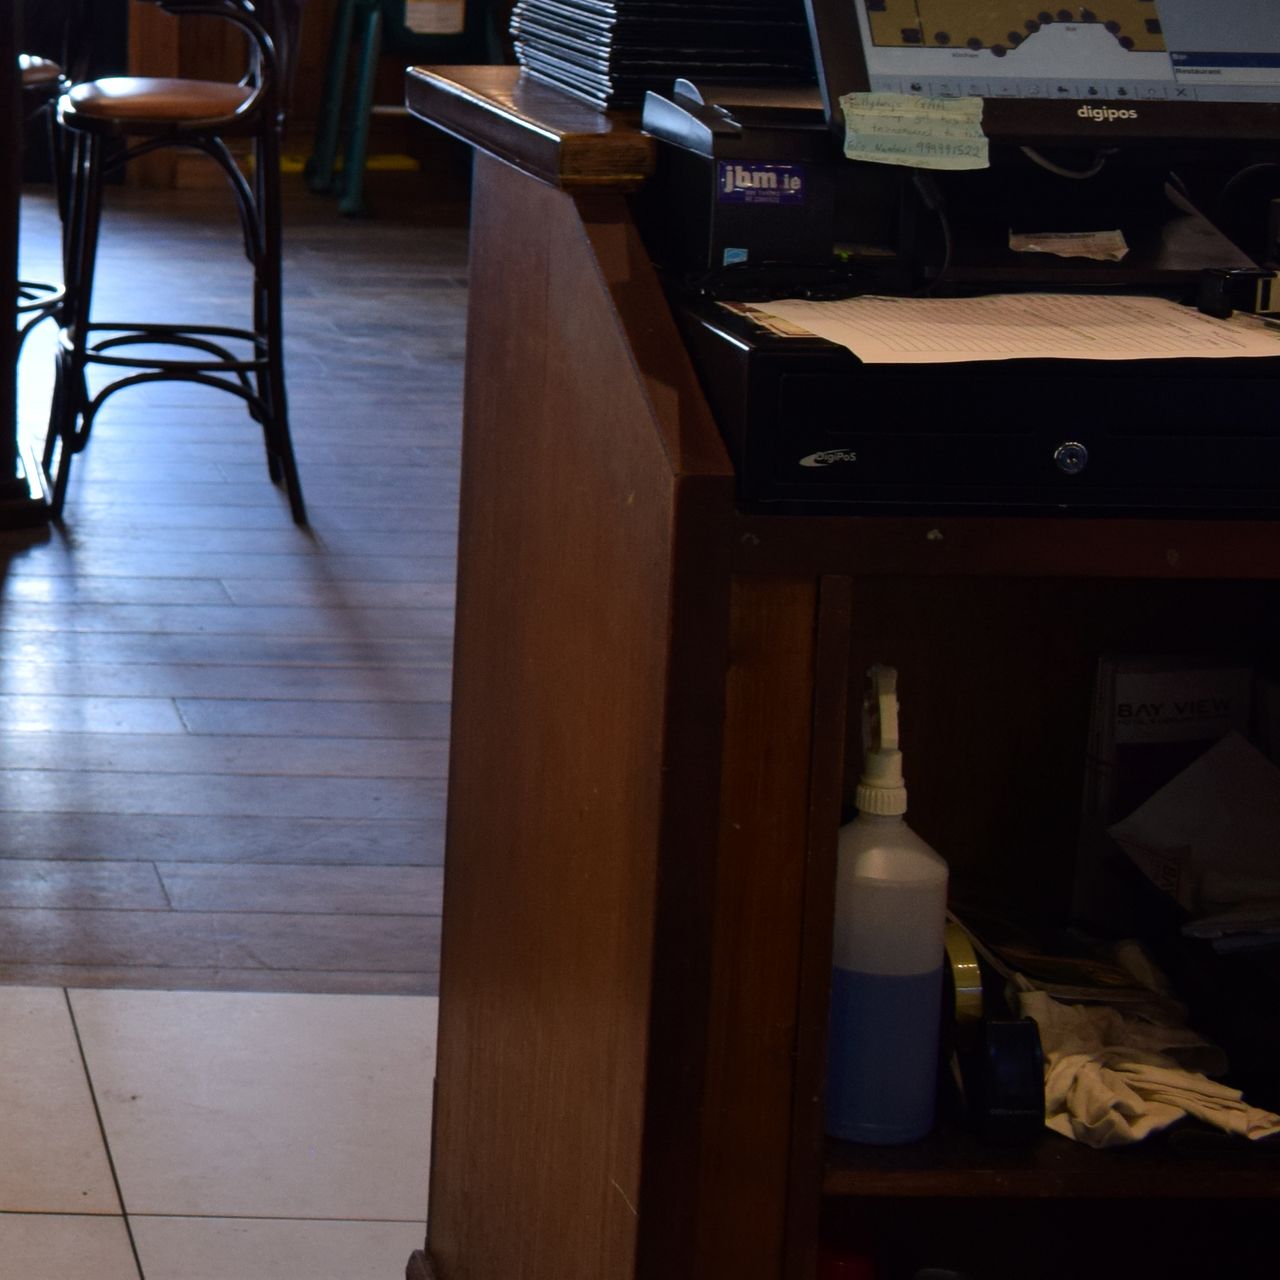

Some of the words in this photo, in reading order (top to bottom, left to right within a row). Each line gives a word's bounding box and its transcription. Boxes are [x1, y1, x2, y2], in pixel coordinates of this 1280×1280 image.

[1076, 105, 1138, 122] digipos
[1117, 702, 1164, 718] BAY
[1174, 697, 1235, 715] VIEW
